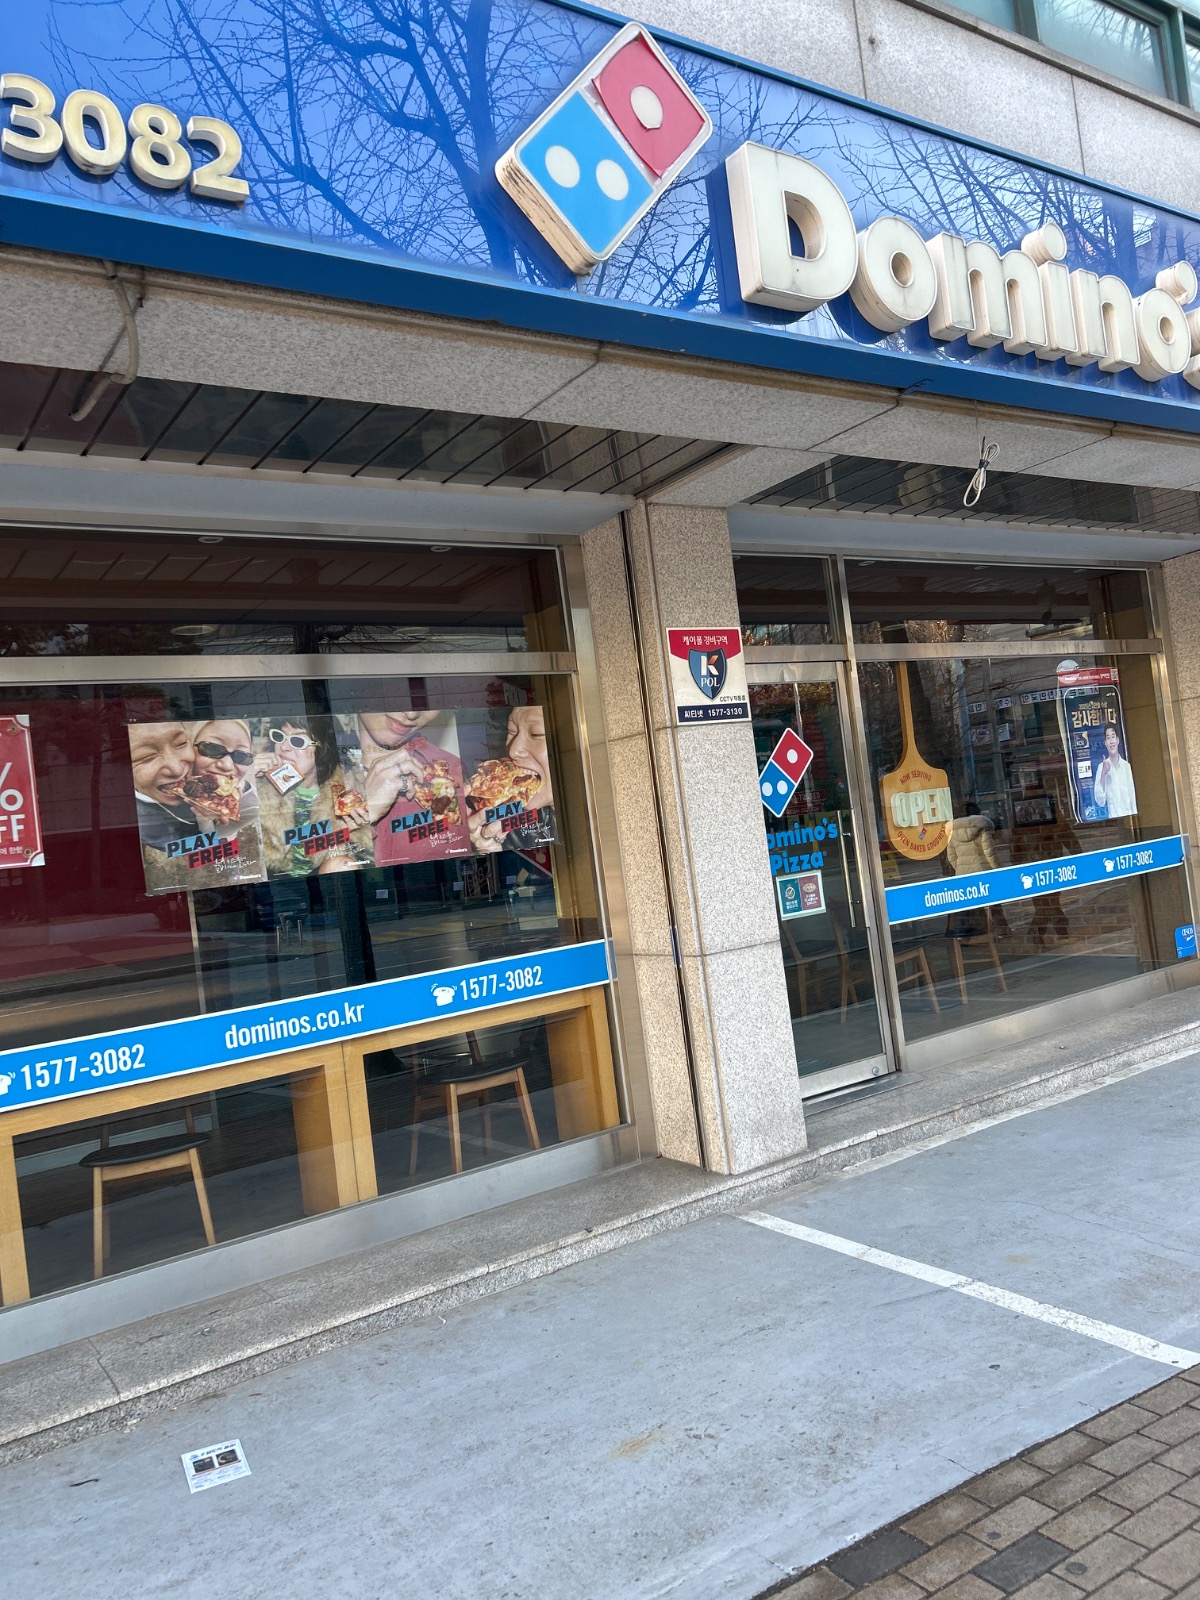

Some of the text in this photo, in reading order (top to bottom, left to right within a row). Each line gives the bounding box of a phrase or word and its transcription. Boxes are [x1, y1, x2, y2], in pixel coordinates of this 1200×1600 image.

[0, 73, 250, 202] 3082
[725, 141, 1200, 389] Domino'
[704, 635, 728, 645] 경비구역
[700, 655, 719, 676] K
[701, 677, 720, 688] POL
[708, 707, 743, 717] 1577-3130
[1071, 708, 1117, 728] 감사합니다
[486, 801, 521, 823] PLAY
[891, 787, 953, 827] OPEN
[285, 820, 330, 844] PLAY
[391, 810, 431, 833] PLAY
[409, 819, 448, 843] FREE.
[502, 810, 537, 833] FREE.
[766, 817, 838, 849] omino's
[167, 831, 217, 858] PLAY
[304, 829, 349, 855] FREE.
[189, 842, 238, 869] FREE.
[770, 851, 824, 876] Pizza
[1116, 850, 1153, 870] 1577-3082
[1034, 865, 1078, 887] 1577-3082
[924, 882, 990, 907] dominos.co.kr
[460, 965, 543, 1001] 1577-3082
[225, 1002, 365, 1049] dominos.co.kr
[20, 1043, 146, 1091] 1577-3082
